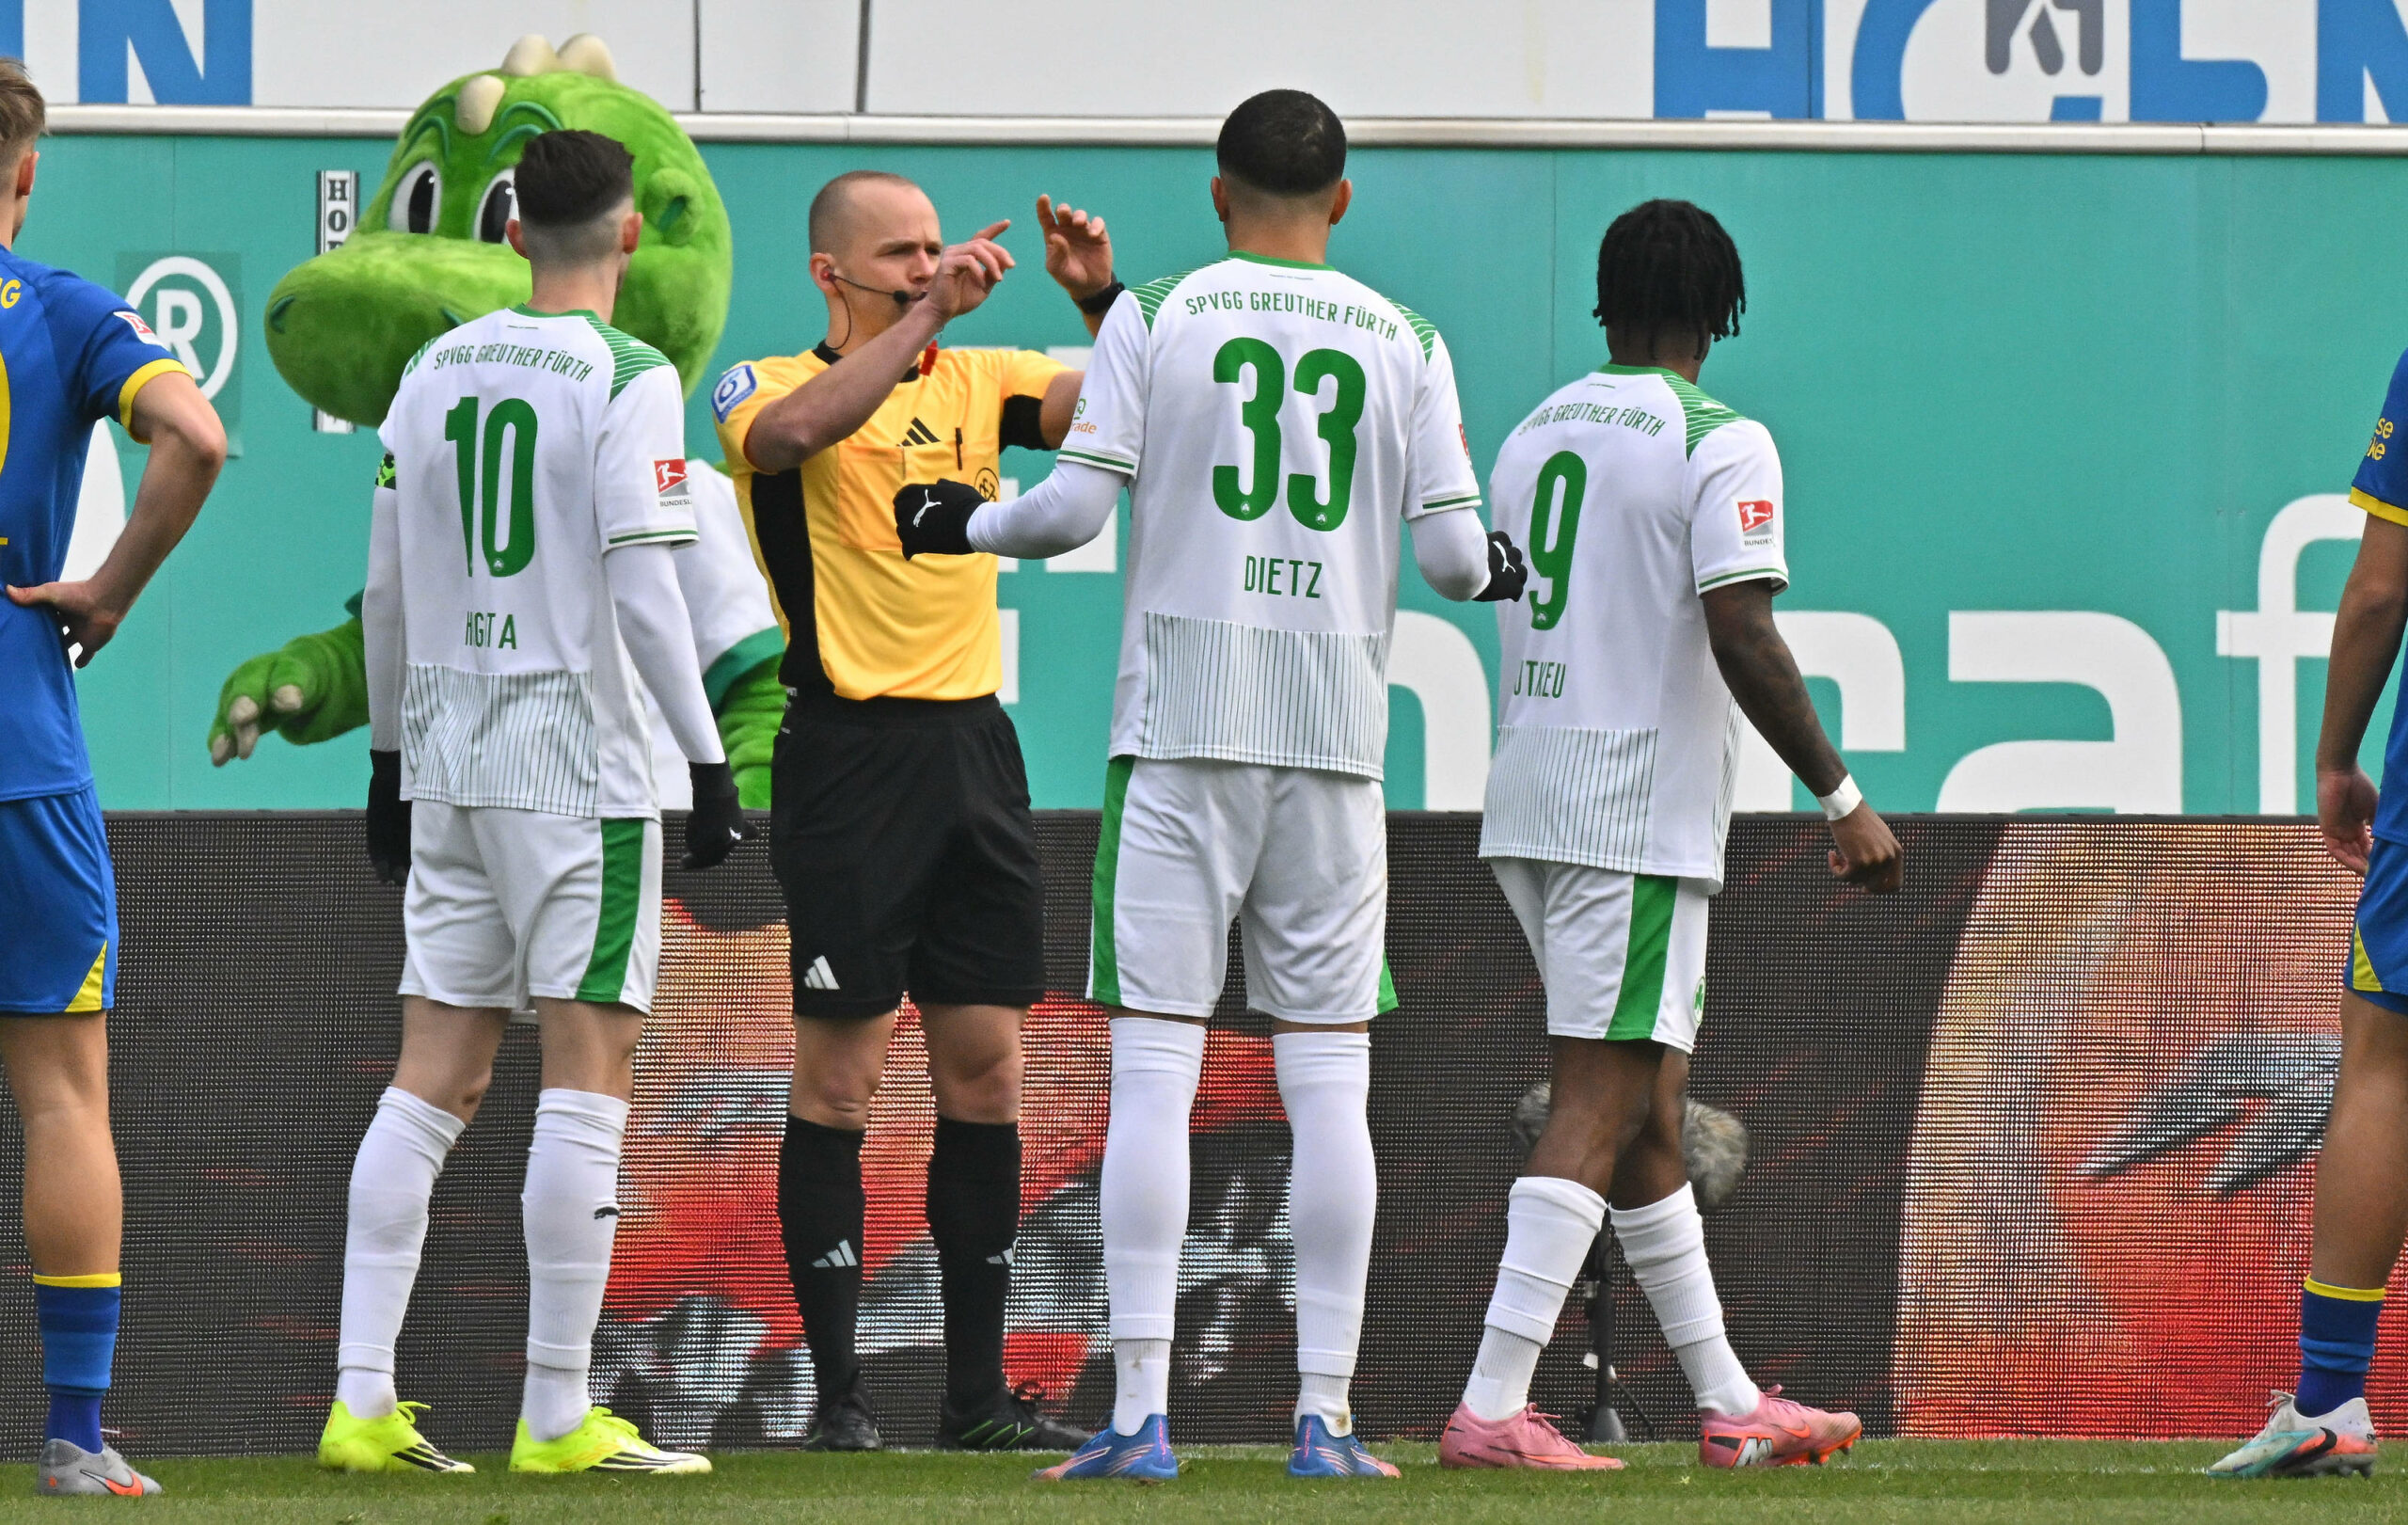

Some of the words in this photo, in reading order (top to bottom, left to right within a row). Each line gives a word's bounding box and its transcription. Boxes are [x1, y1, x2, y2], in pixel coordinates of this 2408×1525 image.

[1185, 292, 1244, 315] SPVGG
[1249, 292, 1339, 323] GREUTHER
[1343, 306, 1399, 342] FÜRTH
[434, 345, 475, 371] SPVGG
[542, 349, 594, 383] FÜRTH
[1212, 337, 1367, 532] 33
[1552, 403, 1618, 425] GREUTHER
[1617, 405, 1666, 437] FÜRTH
[445, 396, 538, 578] 10
[659, 499, 692, 507] BUNDESL
[1529, 450, 1588, 631] 9
[1244, 555, 1323, 599] DIETZ
